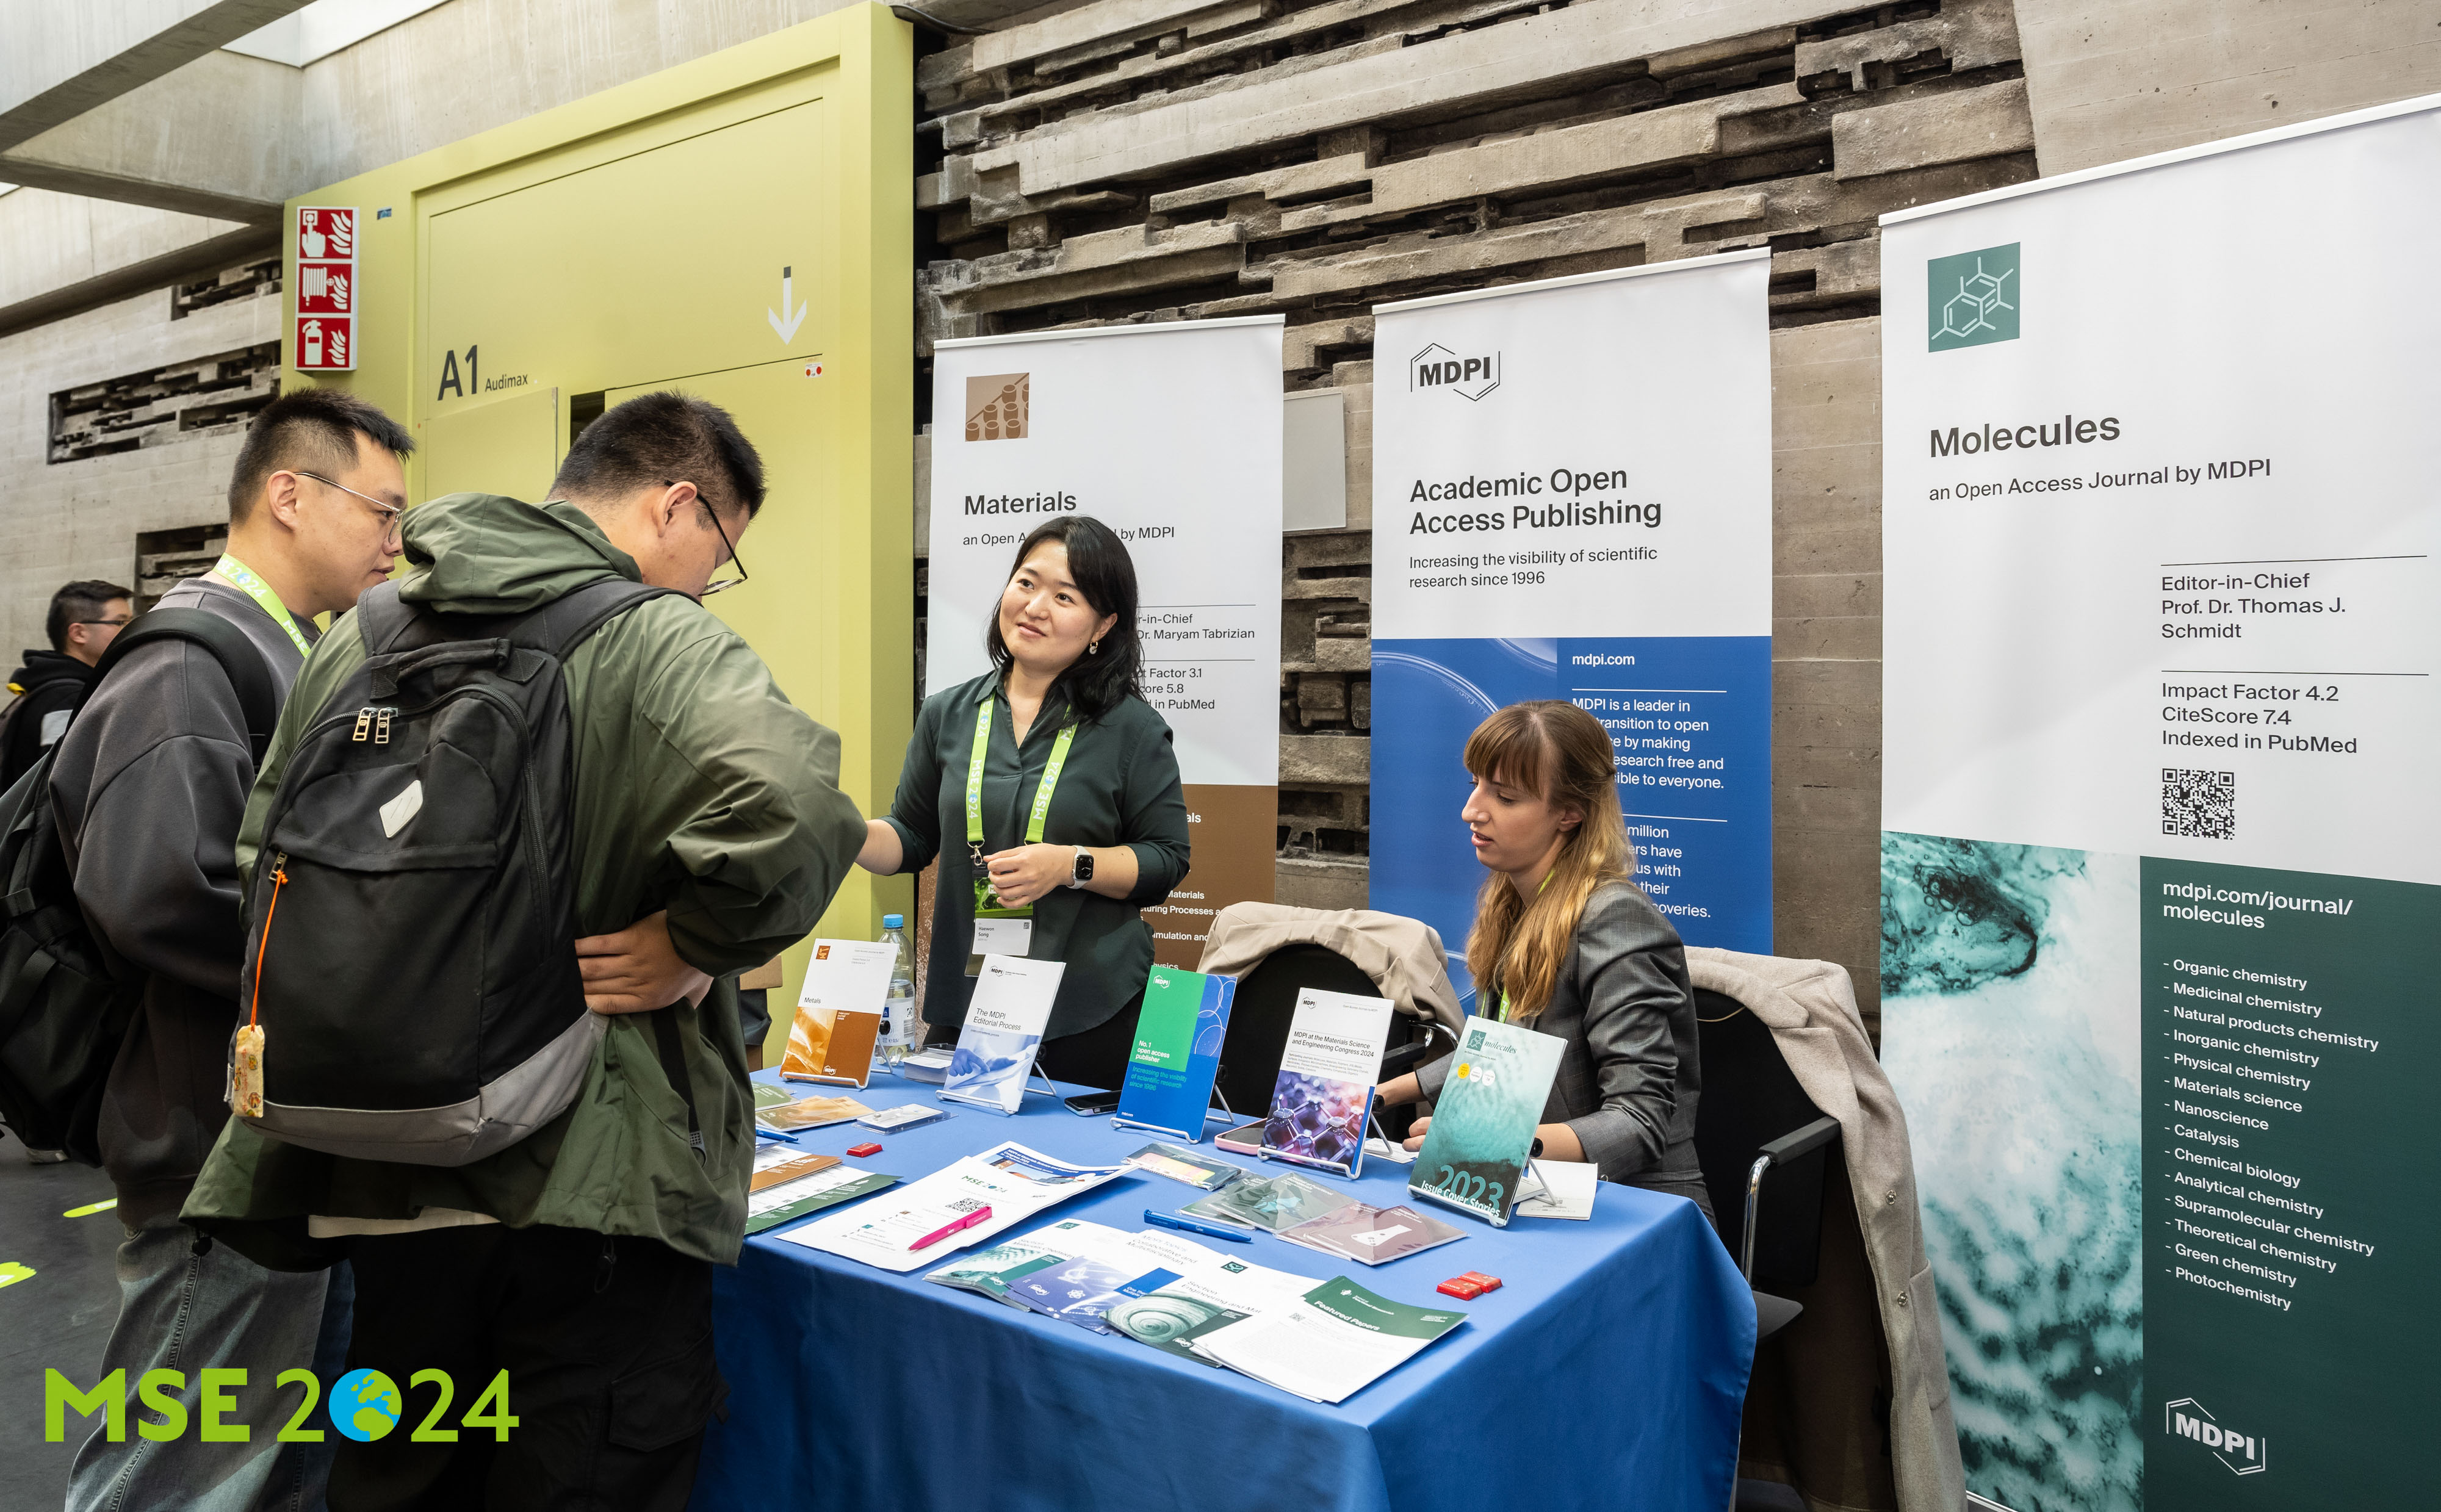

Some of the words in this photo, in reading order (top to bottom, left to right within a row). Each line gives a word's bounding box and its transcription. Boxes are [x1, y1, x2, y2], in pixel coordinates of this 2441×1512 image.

[438, 345, 478, 400] A1
[485, 375, 528, 392] Audimax
[1420, 357, 1490, 387] MDPI
[1931, 415, 2119, 458] Molecules
[1410, 472, 1541, 502] Academic
[1551, 469, 1626, 497] Open
[1930, 488, 1949, 500] an
[1956, 483, 2002, 500] Open
[2008, 478, 2082, 494] Access
[2088, 467, 2168, 488] Journal
[2176, 466, 2201, 484] by
[2208, 459, 2270, 480] MDPI
[965, 491, 1076, 515] Materials
[1410, 513, 1504, 534] Access
[1513, 500, 1660, 528] Publishing
[981, 534, 1014, 546] Open
[1121, 528, 1135, 541] by
[1139, 527, 1174, 538] MDPI
[1410, 555, 1478, 569] Increasing
[1483, 553, 1505, 565] the
[1509, 551, 1565, 565] visibility
[1570, 549, 1584, 562] of
[1589, 547, 1657, 561] scientific
[1410, 574, 1466, 588] research
[1471, 574, 1508, 586] since
[1512, 571, 1545, 584] 1996
[2163, 573, 2309, 591] Editor-in-Chief
[2163, 600, 2202, 614] Prof.
[2209, 600, 2232, 613] Dr.
[2238, 599, 2323, 613] Thomas
[2329, 597, 2345, 612] J.
[283, 620, 307, 652] MSE
[1155, 630, 1199, 641] Maryam
[1202, 628, 1255, 639] Tabrizian
[2162, 624, 2241, 638] Schmidt
[1573, 653, 1634, 667] mdpi.com
[1150, 669, 1186, 678] Factor
[1189, 668, 1202, 678] 3.1
[1167, 684, 1184, 693] 5.8
[2163, 683, 2227, 700] Impact
[2235, 685, 2299, 700] Factor
[2306, 686, 2338, 701] 4.2
[1155, 699, 1164, 709] in
[1169, 699, 1215, 709] PubMed
[1573, 698, 1606, 710] MDPI
[1610, 699, 1619, 710] is
[1623, 702, 1629, 710] a
[1634, 699, 1675, 711] leader
[1679, 700, 1690, 711] in
[1657, 719, 1670, 730] to
[1675, 721, 1708, 732] open
[2163, 707, 2258, 724] CiteScore
[2263, 710, 2291, 725] 7.4
[1625, 736, 1639, 749] by
[1643, 737, 1690, 752] making
[2163, 731, 2238, 747] Indexed
[2245, 734, 2261, 749] in
[2269, 735, 2356, 753] PubMed
[970, 759, 982, 785] MSE
[1614, 756, 1664, 768] esearch
[1668, 756, 1694, 768] free
[1698, 758, 1723, 769] and
[1643, 774, 1655, 785] to
[1659, 777, 1723, 789] everyone.
[1033, 792, 1048, 820] MSE
[1628, 824, 1669, 838] million
[1651, 844, 1682, 858] have
[1654, 864, 1681, 877] with
[1640, 881, 1670, 895] their
[2164, 883, 2353, 915] mdpi.com/journal/
[1170, 905, 1214, 915] Processes
[2164, 905, 2264, 928] molecules
[2174, 959, 2229, 977] Organic
[2233, 969, 2307, 991] chemistry
[2174, 982, 2242, 1003] Medicinal
[2246, 995, 2321, 1018] chemistry
[973, 1017, 998, 1027] Editorial
[999, 1021, 1021, 1030] Process
[977, 1008, 988, 1017] The
[2174, 1006, 2224, 1024] Natural
[2229, 1018, 2295, 1036] products
[2298, 1028, 2379, 1052] chemistry
[1302, 1040, 1334, 1051] Engineering
[1335, 1046, 1360, 1055] Congress
[1324, 1037, 1348, 1045] Materials
[1349, 1040, 1370, 1049] Science
[1484, 1041, 1517, 1054] molecules
[2174, 1029, 2240, 1051] Inorganic
[2244, 1043, 2319, 1067] chemistry
[1136, 1054, 1160, 1063] publisher
[2175, 1053, 2232, 1074] Physical
[2236, 1066, 2310, 1090] chemistry
[2175, 1076, 2240, 1100] Materials
[2244, 1093, 2302, 1112] science
[2175, 1100, 2268, 1129] Nanoscience
[2175, 1125, 2239, 1148] Catalysis
[2175, 1148, 2242, 1173] Chemical
[2247, 1164, 2300, 1188] biology
[962, 1175, 984, 1186] MSE
[1436, 1165, 1504, 1211] 2023
[1421, 1180, 1441, 1197] Issue
[1443, 1187, 1468, 1205] Cover
[1469, 1197, 1501, 1217] Stories
[2175, 1172, 2244, 1198] Analytical
[2248, 1191, 2323, 1219] chemistry
[2175, 1195, 2290, 1234] Supramolecular
[2295, 1227, 2374, 1256] chemistry
[2175, 1219, 2255, 1250] Theoretical
[2260, 1244, 2336, 1273] chemistry
[2176, 1244, 2218, 1264] Green
[2223, 1258, 2296, 1287] chemistry
[2176, 1267, 2291, 1311] Photochemistry
[1314, 1300, 1352, 1321] Featured
[1350, 1318, 1380, 1331] Papers
[2176, 1413, 2254, 1460] MDPI
